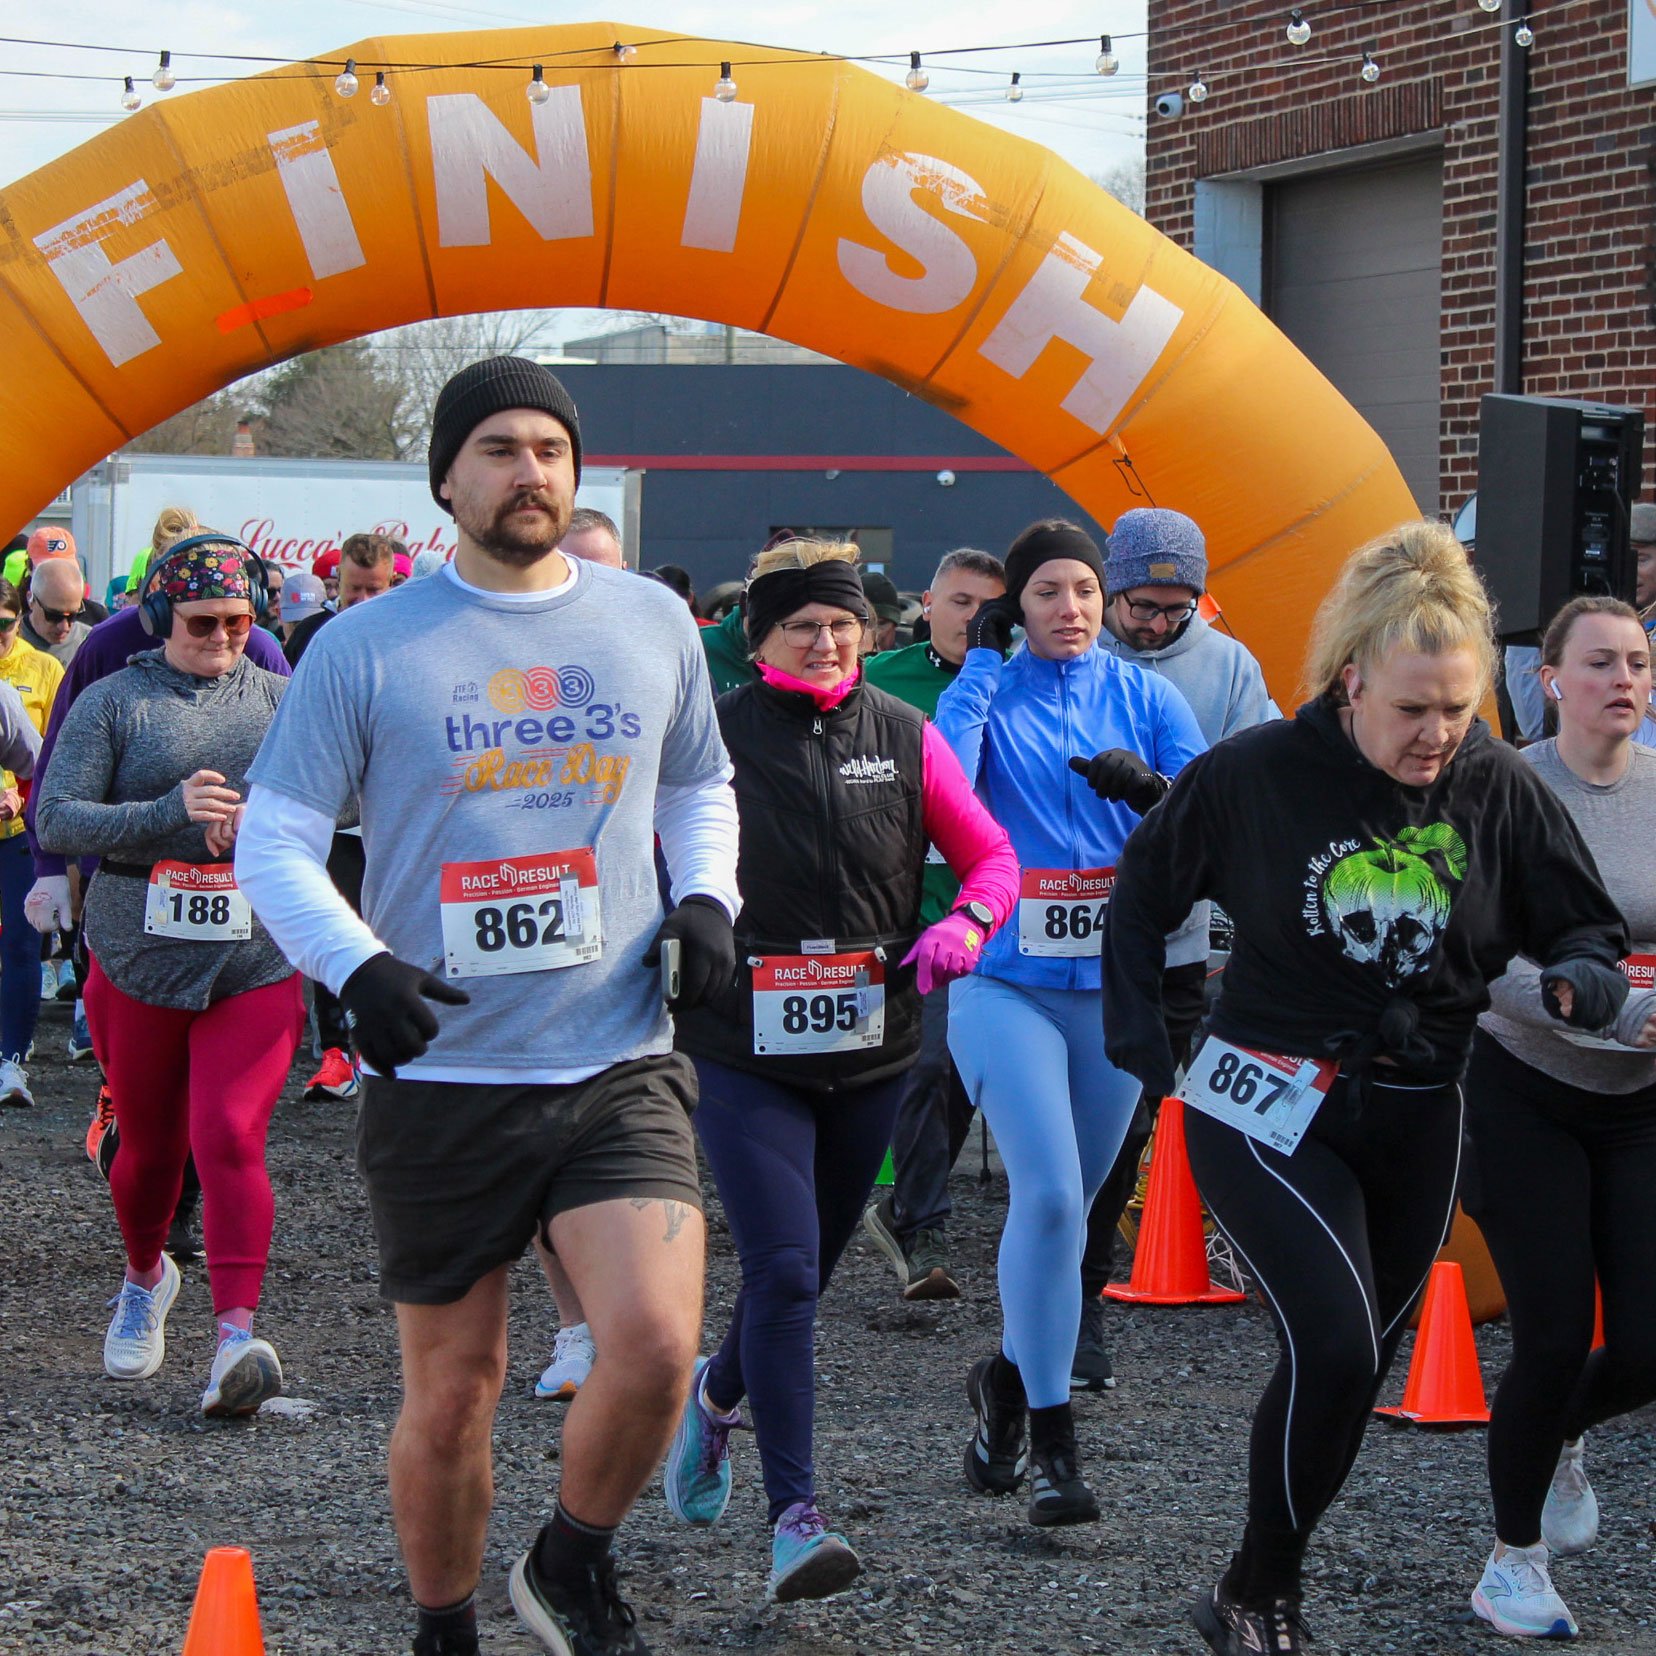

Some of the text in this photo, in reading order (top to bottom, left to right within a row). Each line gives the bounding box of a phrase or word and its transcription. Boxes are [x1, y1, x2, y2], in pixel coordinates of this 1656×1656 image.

[33, 84, 1184, 435] FINISH
[240, 518, 342, 562] Lucca'
[446, 703, 642, 752] three 3's
[464, 742, 631, 805] Race Day
[521, 791, 576, 810] 2025
[202, 872, 233, 883] RESULT
[461, 873, 500, 889] RACE
[1040, 879, 1068, 891] RACE
[1302, 838, 1360, 936] Rotten to the Core
[169, 893, 230, 925] 188
[474, 899, 566, 953] 862
[774, 967, 807, 980] RACE
[782, 993, 859, 1034] 895
[1208, 1052, 1291, 1116] 867
